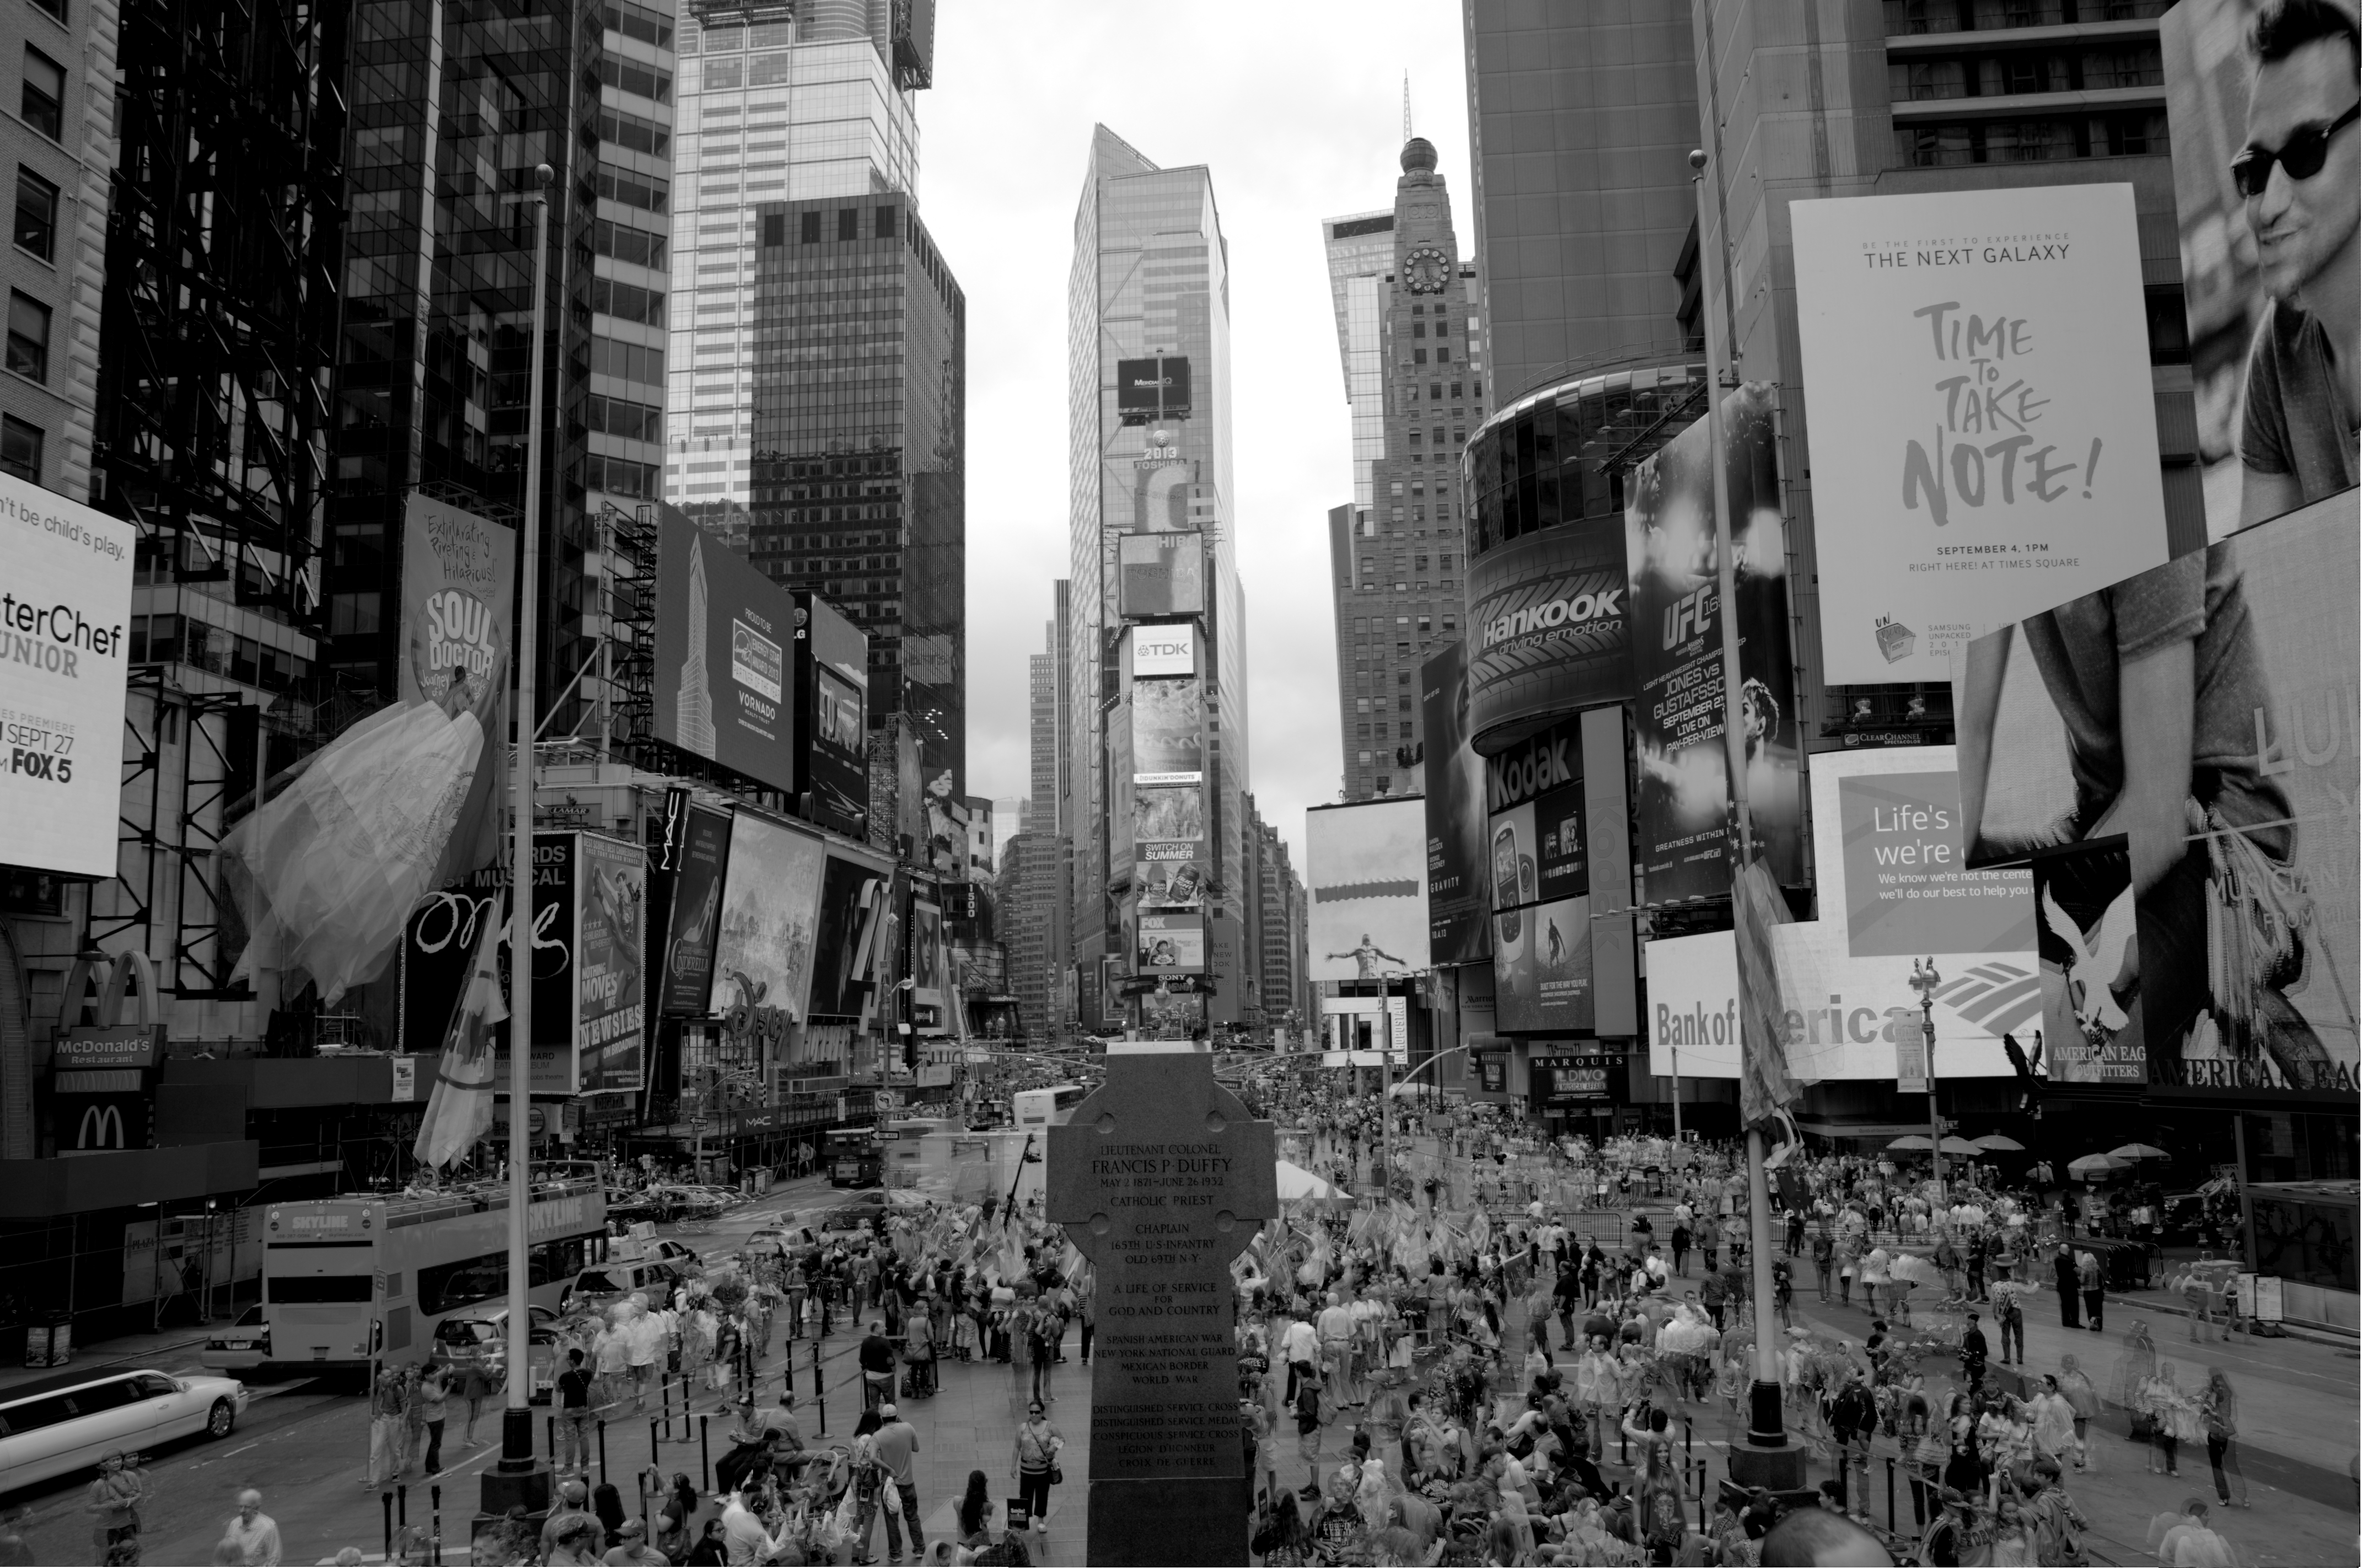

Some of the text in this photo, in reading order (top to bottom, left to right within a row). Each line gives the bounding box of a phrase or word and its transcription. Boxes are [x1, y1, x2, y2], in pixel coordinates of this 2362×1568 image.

[1917, 238, 1954, 247] FIRST
[1963, 237, 1978, 245] TO
[1987, 232, 2070, 244] EXPERIENCE
[1864, 243, 2071, 269] THE NEXT GALAXY
[1913, 300, 2033, 361] TIME
[1970, 358, 1999, 386] TO
[1934, 375, 2051, 434] TAKE
[1144, 447, 1178, 460] 2013
[1135, 460, 1187, 469] TOSHIBA
[1902, 422, 2103, 528] NOTE!
[19, 503, 125, 561] be child's play.
[1936, 543, 2049, 556] SEPTEMBER 4, 1PM
[1909, 558, 2080, 572] RIGHT HERE! AT TIMES SQUARE
[426, 591, 495, 653] SOUL
[745, 607, 760, 626] PROUD
[1662, 584, 1712, 651] UFC
[1928, 624, 1971, 632] SAMSUNG
[1499, 619, 1622, 656] driving emotion
[1928, 631, 1972, 640] UNPACKED
[1149, 643, 1189, 656] TDK
[430, 640, 495, 681] DOCTOR
[1643, 660, 1696, 691] LIGHT HEAVYWEIGHT
[1665, 666, 1701, 698] JONES
[738, 690, 776, 720] VORNADO
[744, 708, 758, 719] REALTY
[1663, 700, 1713, 729] SEPTEMBER
[20, 713, 76, 734] PREMIERE
[1677, 715, 1711, 737] LIVE ON
[7, 723, 74, 755] SEPT 27
[1666, 723, 1725, 754] PAY-PER-VIEW
[12, 748, 72, 783] FOX 5
[1493, 726, 1571, 812] Kodak
[1875, 804, 1950, 832] Life's
[584, 837, 616, 853] BEST BEST
[1145, 842, 1194, 852] SWITCH ON
[1655, 828, 1725, 852] GREATNESS WITHIN
[1429, 842, 1443, 853] BULLOCK
[1875, 839, 1950, 866] we're
[598, 849, 608, 857] TONY
[609, 853, 622, 861] AWARD
[1145, 851, 1194, 861] SUMMER
[1429, 860, 1445, 871] CLOONEY
[1177, 875, 1194, 885] BUD
[1589, 796, 1628, 952] Kodak
[1878, 869, 2000, 884] We know we're not the
[1174, 878, 1193, 890] LIGHT
[1430, 876, 1459, 893] GRAVITY
[1879, 885, 2031, 900] we'll do our best to help you
[1141, 917, 1166, 929] FOX
[2263, 906, 2315, 932] FROM
[1431, 929, 1447, 939] 10.4.13
[582, 962, 606, 981] NOTHING
[581, 971, 618, 1005] MOVES
[1540, 982, 1549, 991] BUILT
[604, 996, 616, 1011] LIKE
[579, 1003, 641, 1050] NEWSIES
[56, 1039, 150, 1055] McDonald's
[603, 1034, 640, 1060] ON BROADWAY
[2053, 1045, 2117, 1063] AMERICAN
[71, 1055, 133, 1064] Restaurant
[1535, 1056, 1623, 1067] MARQUIS
[1569, 1069, 1606, 1082] DIVO
[2076, 1064, 2140, 1078] OUTFITTERS
[2150, 1057, 2301, 1090] AMERICAN
[1562, 1082, 1605, 1091] MUSICAL AFFAIR
[1100, 1143, 1221, 1156] LIEUTENANT COLONEL
[1101, 1178, 1121, 1188] MAY
[1110, 1195, 1214, 1207] CATHOLIC PRIEST
[528, 1196, 583, 1233] SKYLINE
[292, 1215, 348, 1229] SKYLINE
[1135, 1223, 1190, 1234] CHAPLAIN
[1125, 1255, 1147, 1264] OLD
[1125, 1282, 1217, 1293] LIFE SERVICE
[1109, 1304, 1221, 1316] GOD AND COUNTRY
[1107, 1334, 1223, 1344] SPANISH AMERICAN WAR
[1119, 1347, 1236, 1358] YORK NATIONAL GUARD
[1121, 1361, 1209, 1372] MEXICAN BORDER
[1132, 1374, 1199, 1385] WORLD WAR
[1092, 1402, 1238, 1415] DISTINGUISHED SERVICE CROSS
[1092, 1416, 1241, 1427] DISTINGUISHED SERVICE MEDAL
[1092, 1430, 1239, 1441] CONSPICUOUS SERVICE CROSS
[1159, 1443, 1216, 1453] D'HONNEUR
[1118, 1458, 1151, 1468] CROIX
